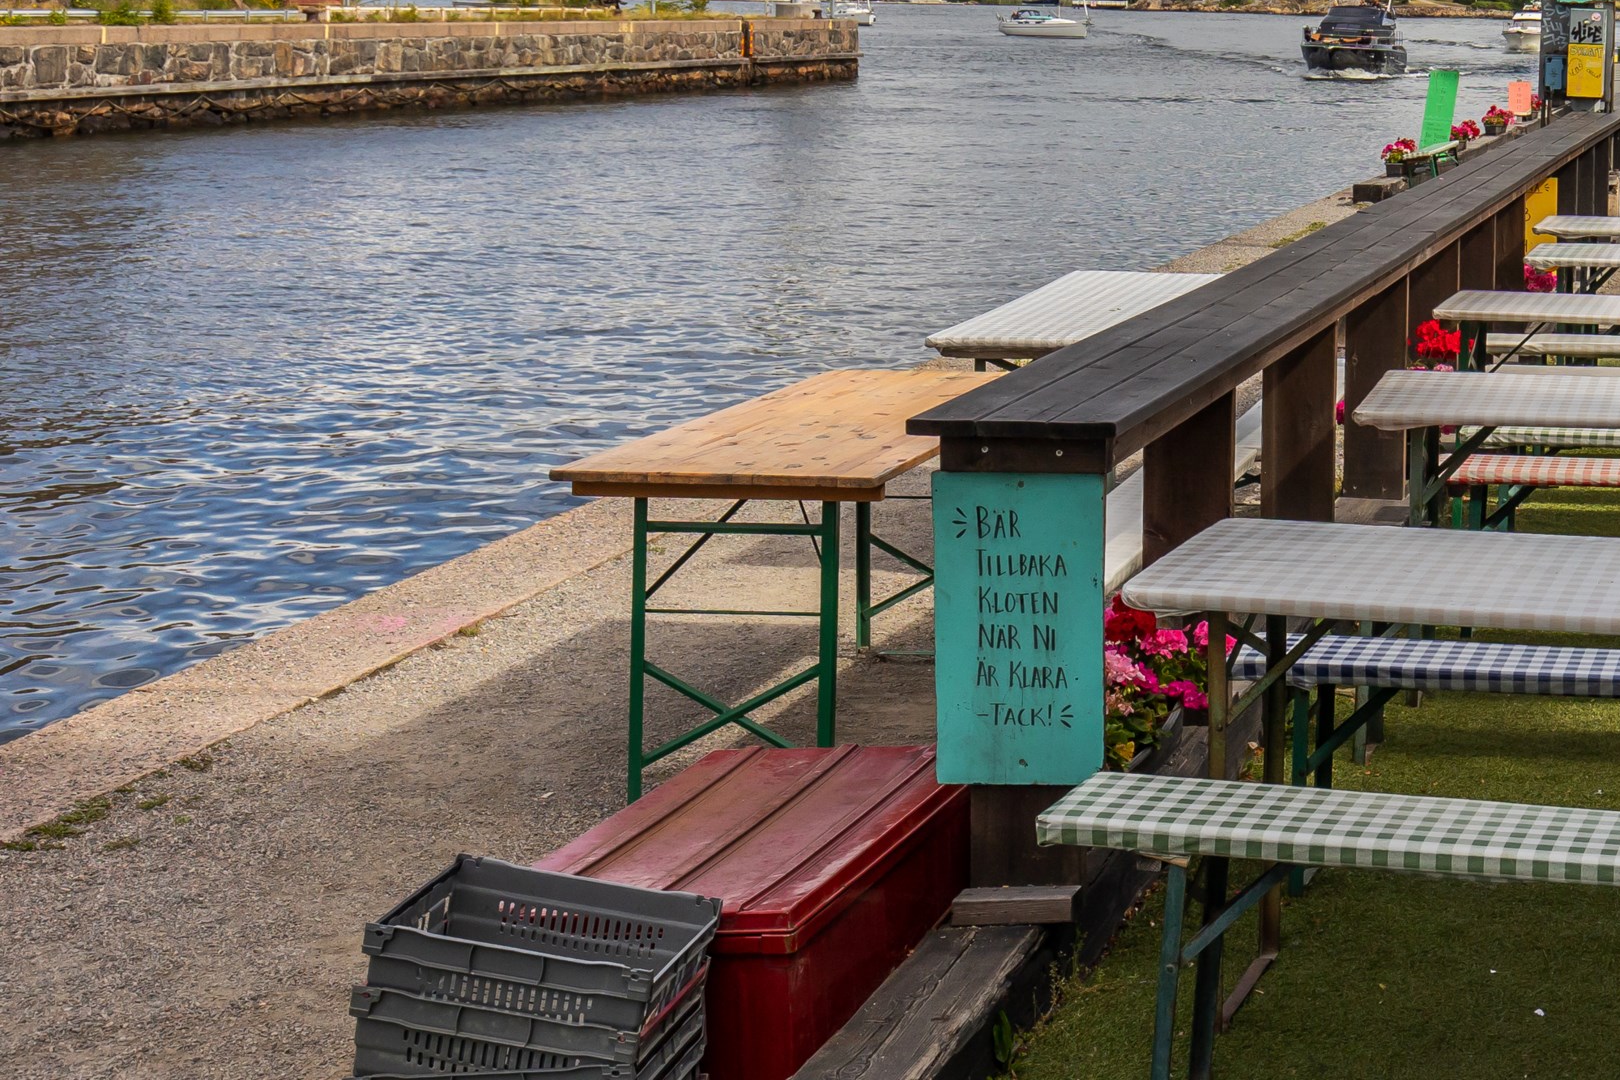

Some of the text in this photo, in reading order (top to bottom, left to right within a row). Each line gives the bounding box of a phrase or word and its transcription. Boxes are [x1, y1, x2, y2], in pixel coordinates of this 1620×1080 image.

[976, 505, 1021, 539] BÄR
[975, 548, 1068, 577] TILLBAKA
[978, 586, 1058, 614] KLOTEN
[978, 623, 1056, 651] NÄR NI
[976, 657, 1068, 689] ÄR KLARA
